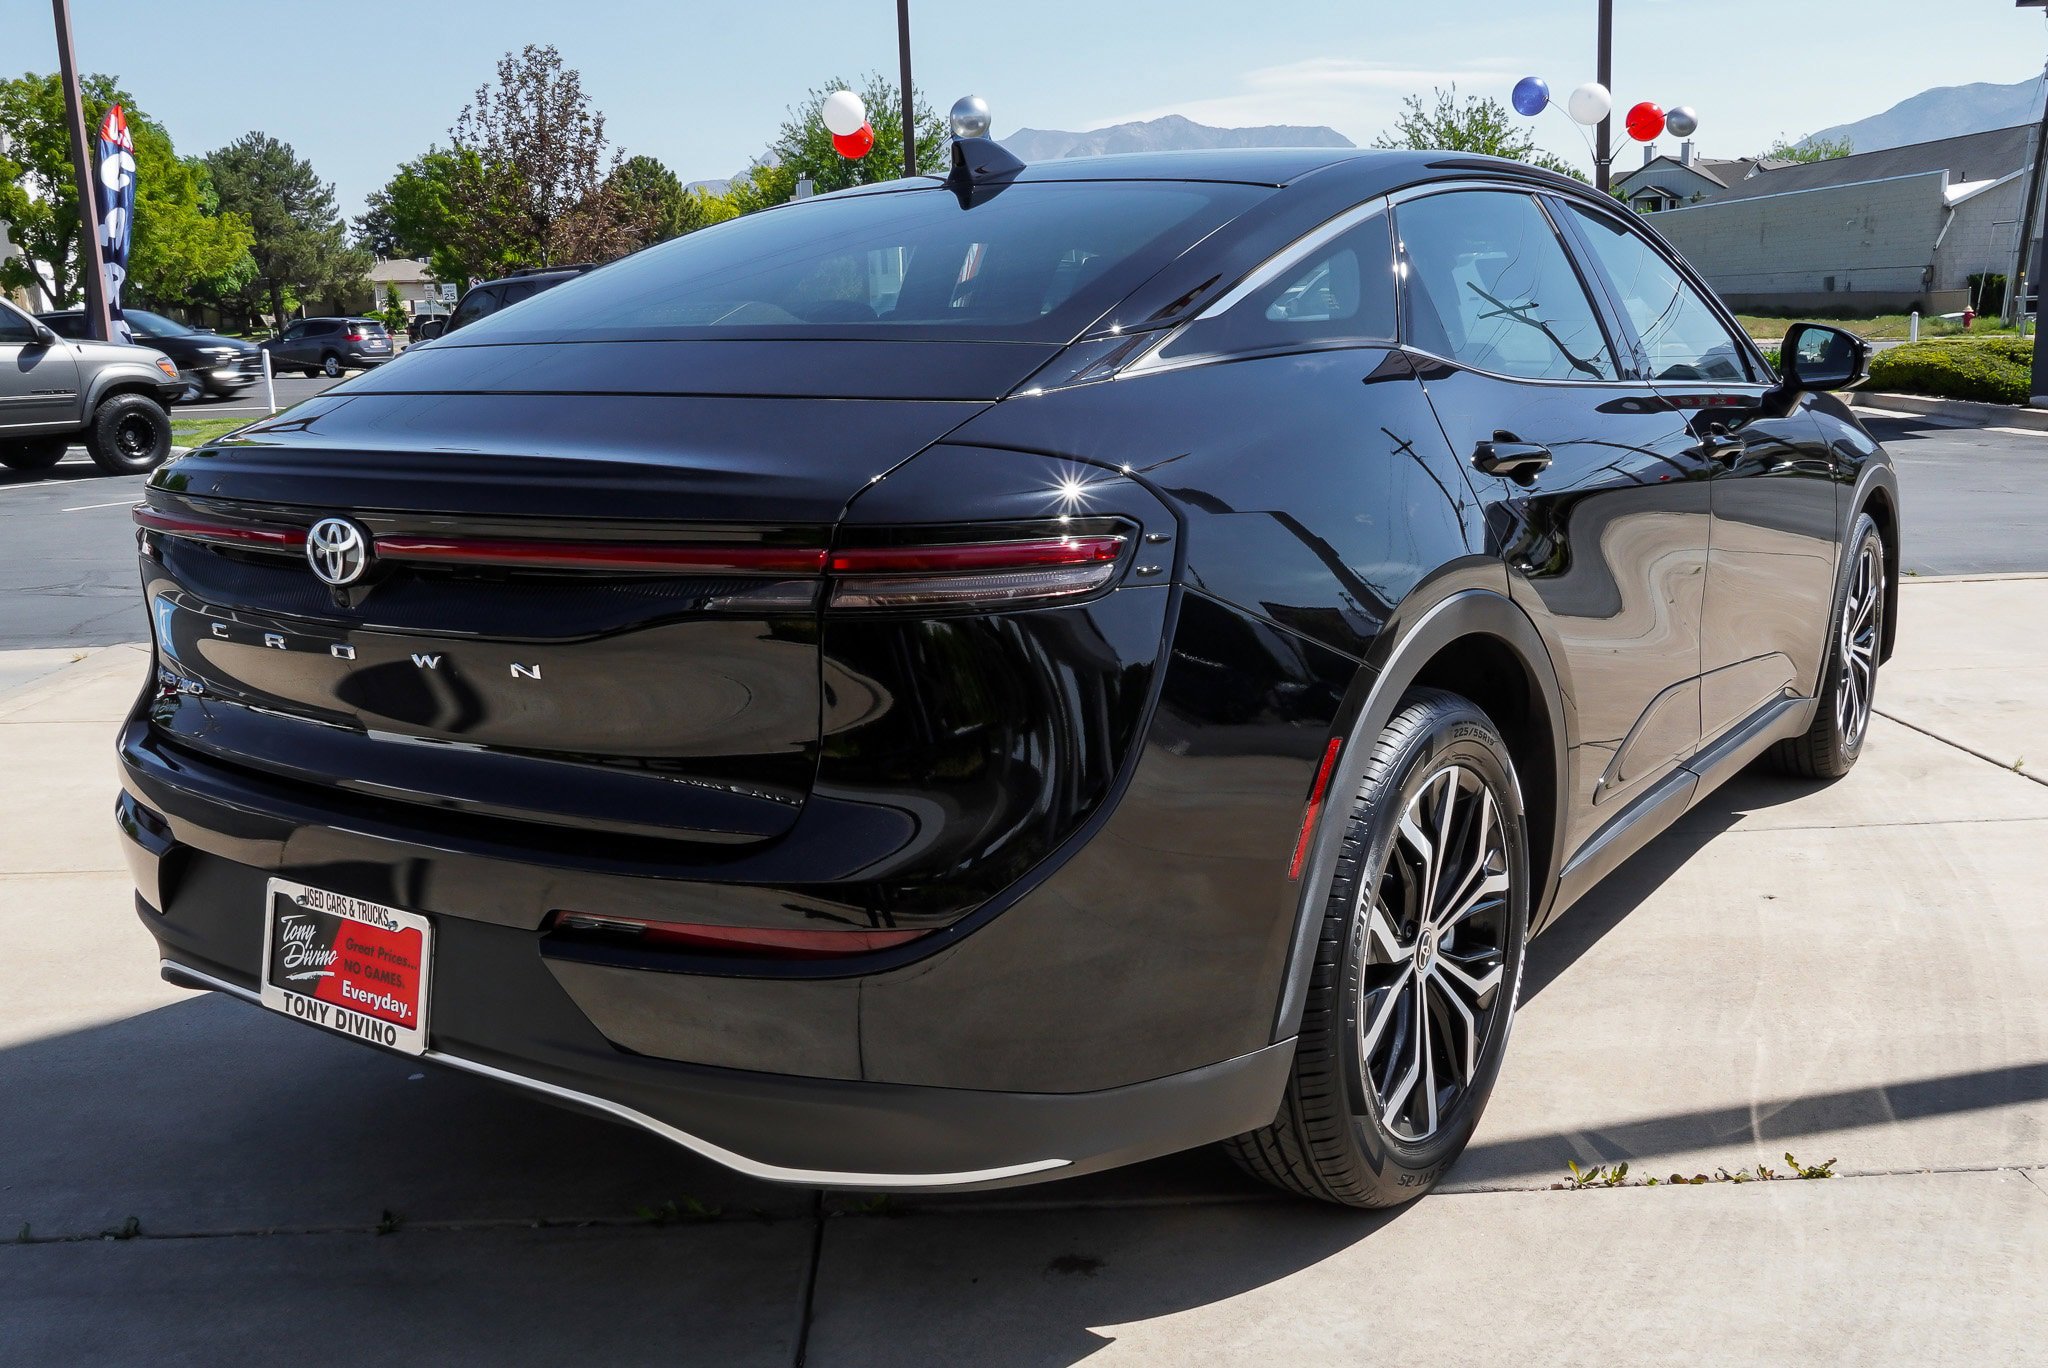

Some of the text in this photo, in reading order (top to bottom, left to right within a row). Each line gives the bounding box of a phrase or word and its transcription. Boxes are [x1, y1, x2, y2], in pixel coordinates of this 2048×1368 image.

[211, 623, 541, 680] CROWN
[1454, 727, 1495, 746] 225/55R19
[304, 887, 389, 927] USED CARS & TRUCKS
[281, 915, 316, 949] Tony
[346, 938, 375, 957] Great
[280, 941, 338, 968] Divino
[344, 958, 361, 974] NO
[342, 980, 412, 1018] Everyday.
[283, 992, 397, 1047] TONY DIVINO
